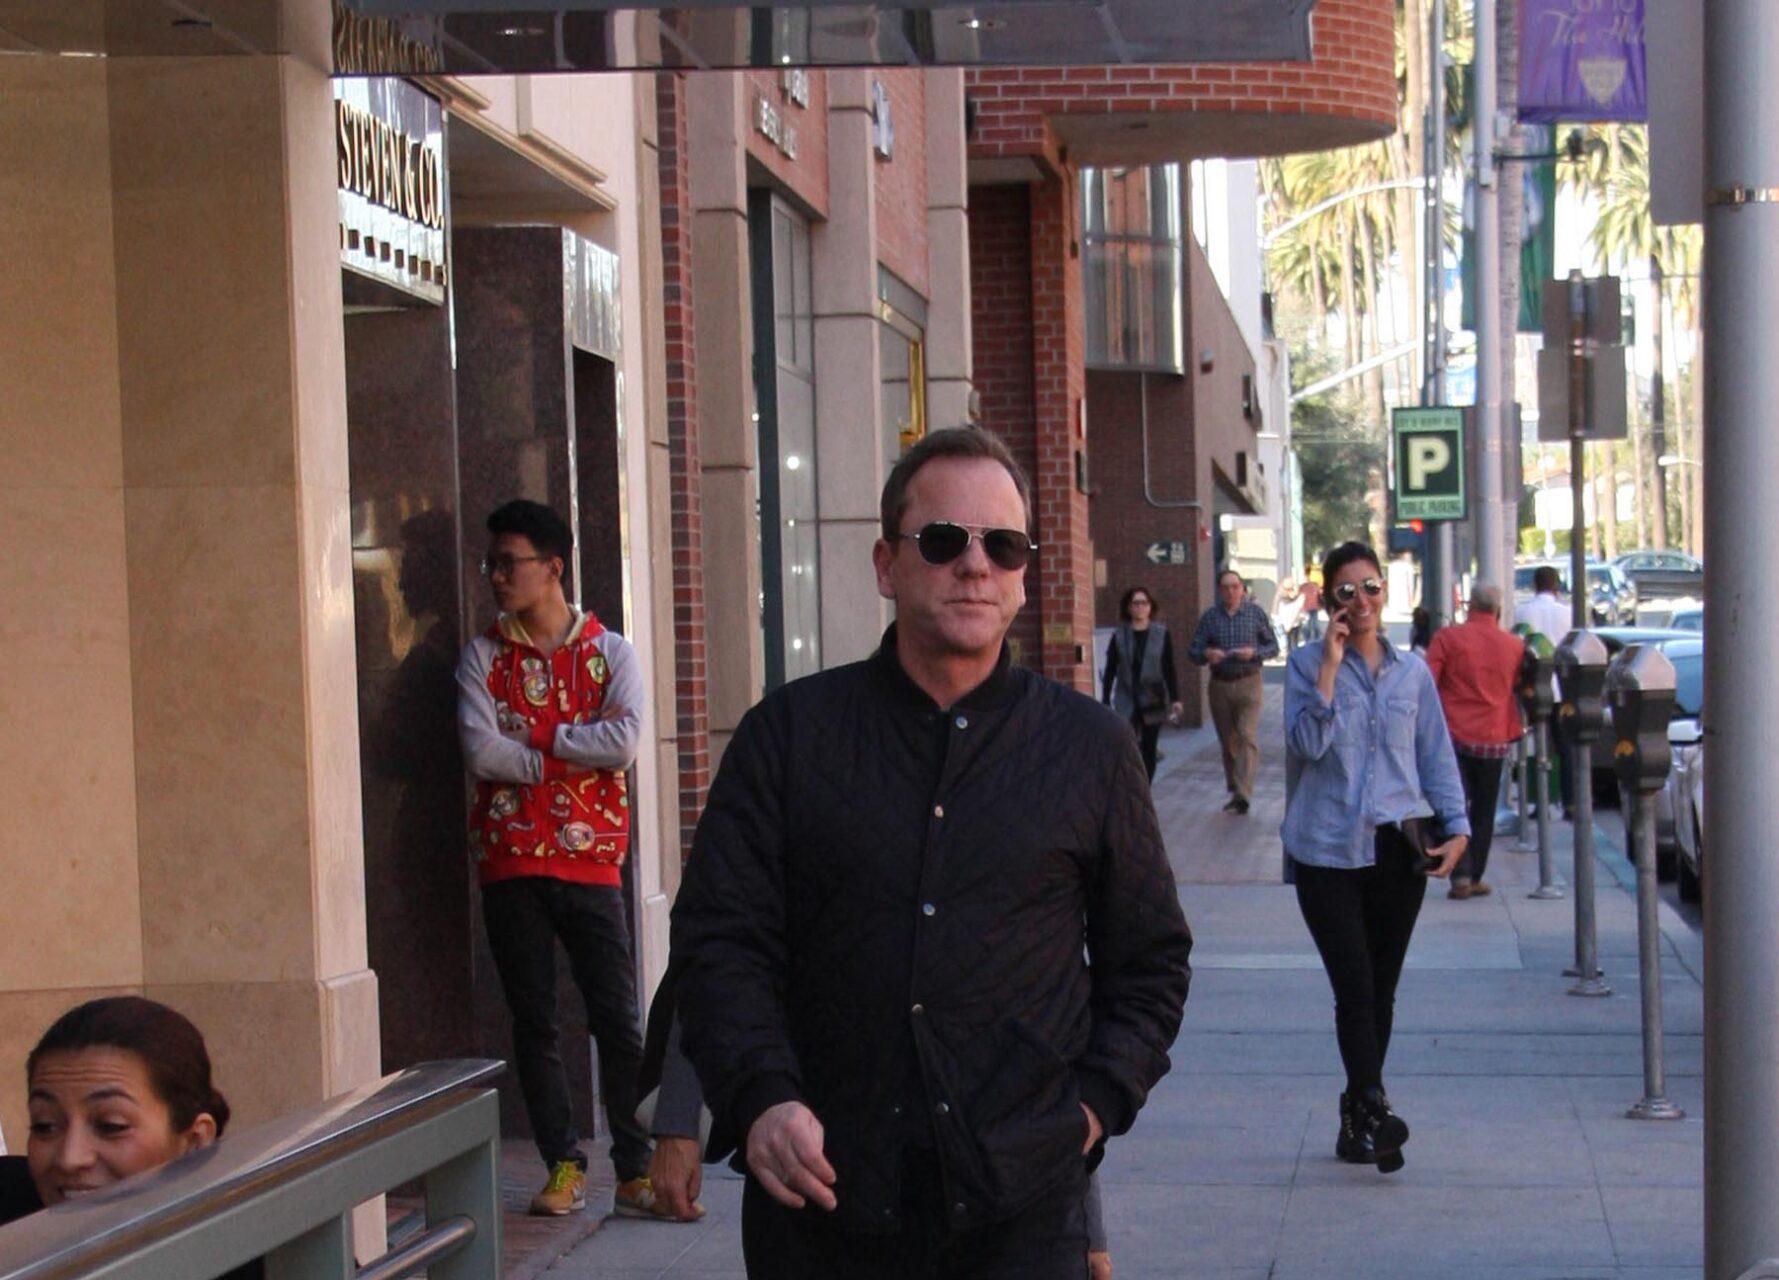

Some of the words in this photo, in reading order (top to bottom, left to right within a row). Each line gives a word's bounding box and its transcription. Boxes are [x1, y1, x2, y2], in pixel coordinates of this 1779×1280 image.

[340, 100, 402, 214] STEVEN
[405, 130, 418, 220] &
[420, 141, 445, 230] CO.
[1408, 437, 1450, 490] P
